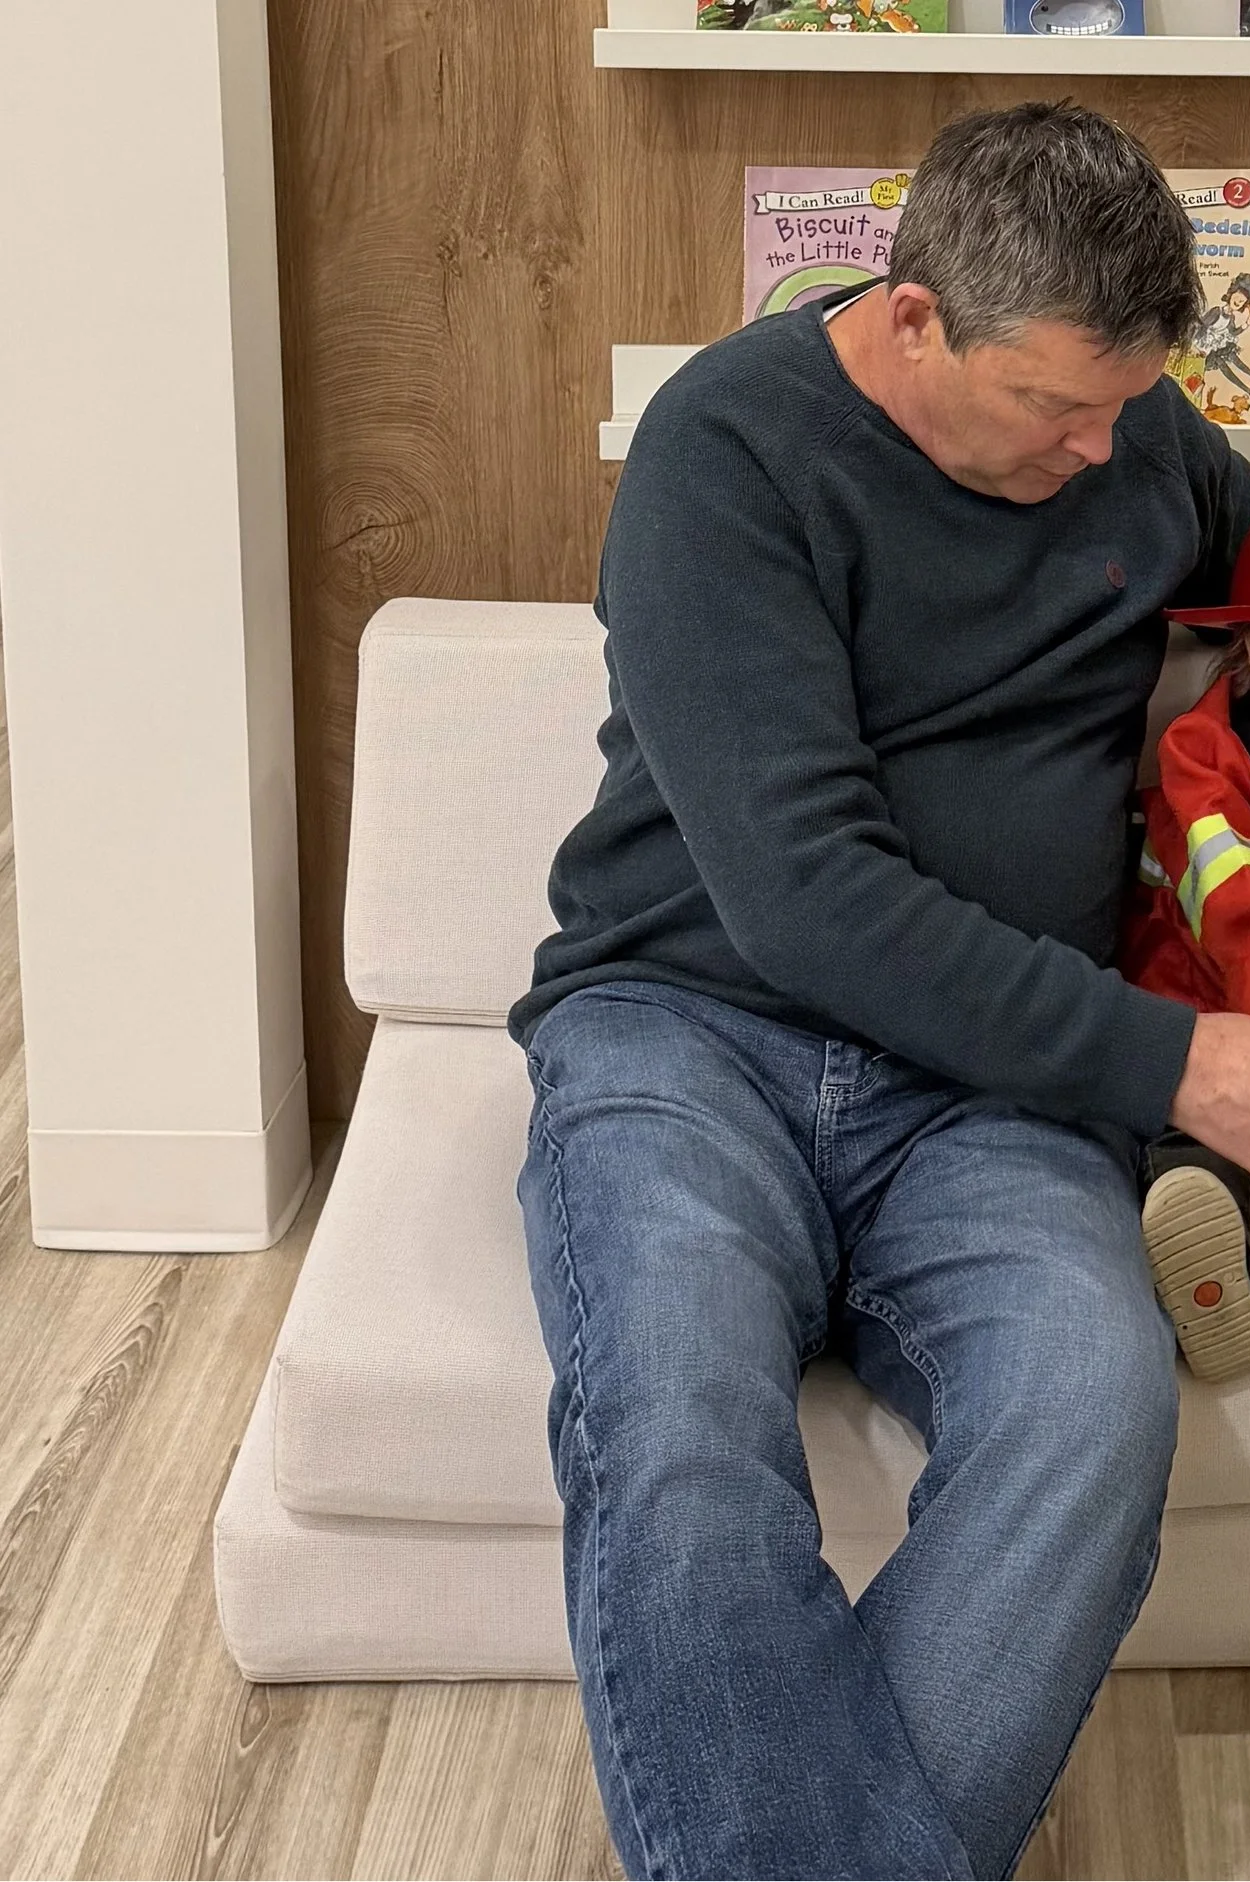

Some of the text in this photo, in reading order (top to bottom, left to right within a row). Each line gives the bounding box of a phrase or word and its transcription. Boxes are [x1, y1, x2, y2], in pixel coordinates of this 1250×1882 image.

[779, 190, 864, 208] I Can Read!
[1177, 190, 1217, 206] Read!
[1233, 184, 1243, 199] 2
[775, 214, 894, 243] Biscuit an
[766, 241, 892, 268] the Little Pu
[1192, 244, 1245, 258] worm
